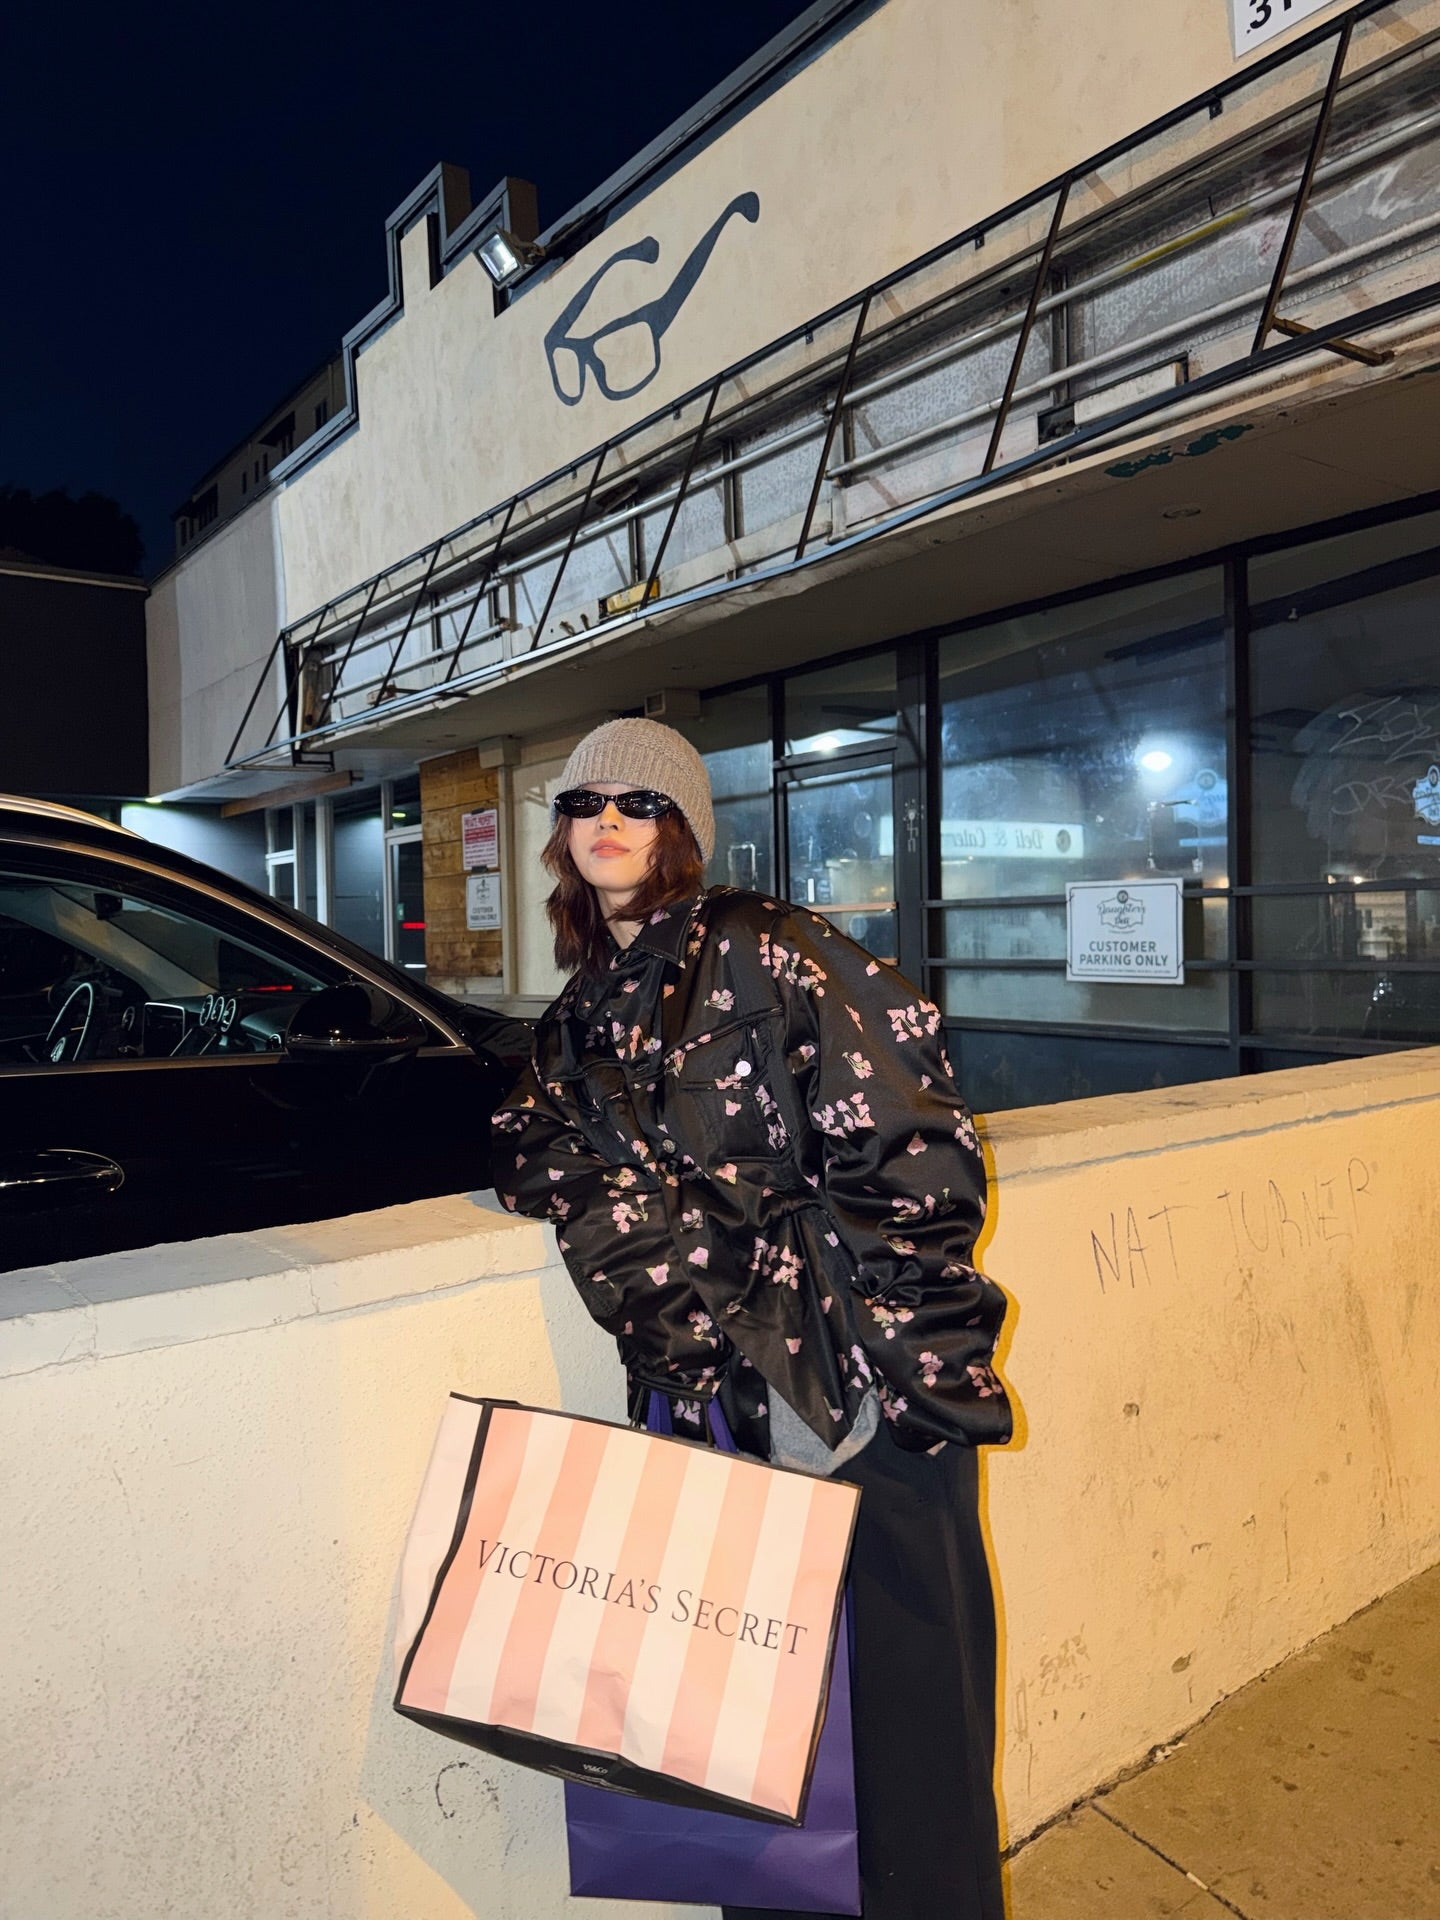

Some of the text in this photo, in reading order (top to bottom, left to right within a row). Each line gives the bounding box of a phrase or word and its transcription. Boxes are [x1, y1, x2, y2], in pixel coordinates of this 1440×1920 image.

[1249, 0, 1291, 29] 3
[1080, 954, 1168, 966] PARKING ONLY
[1089, 941, 1156, 953] CUSTOMER
[1091, 1157, 1371, 1294] NAT TURNER
[477, 1539, 808, 1655] VICTORIA'S SECRET
